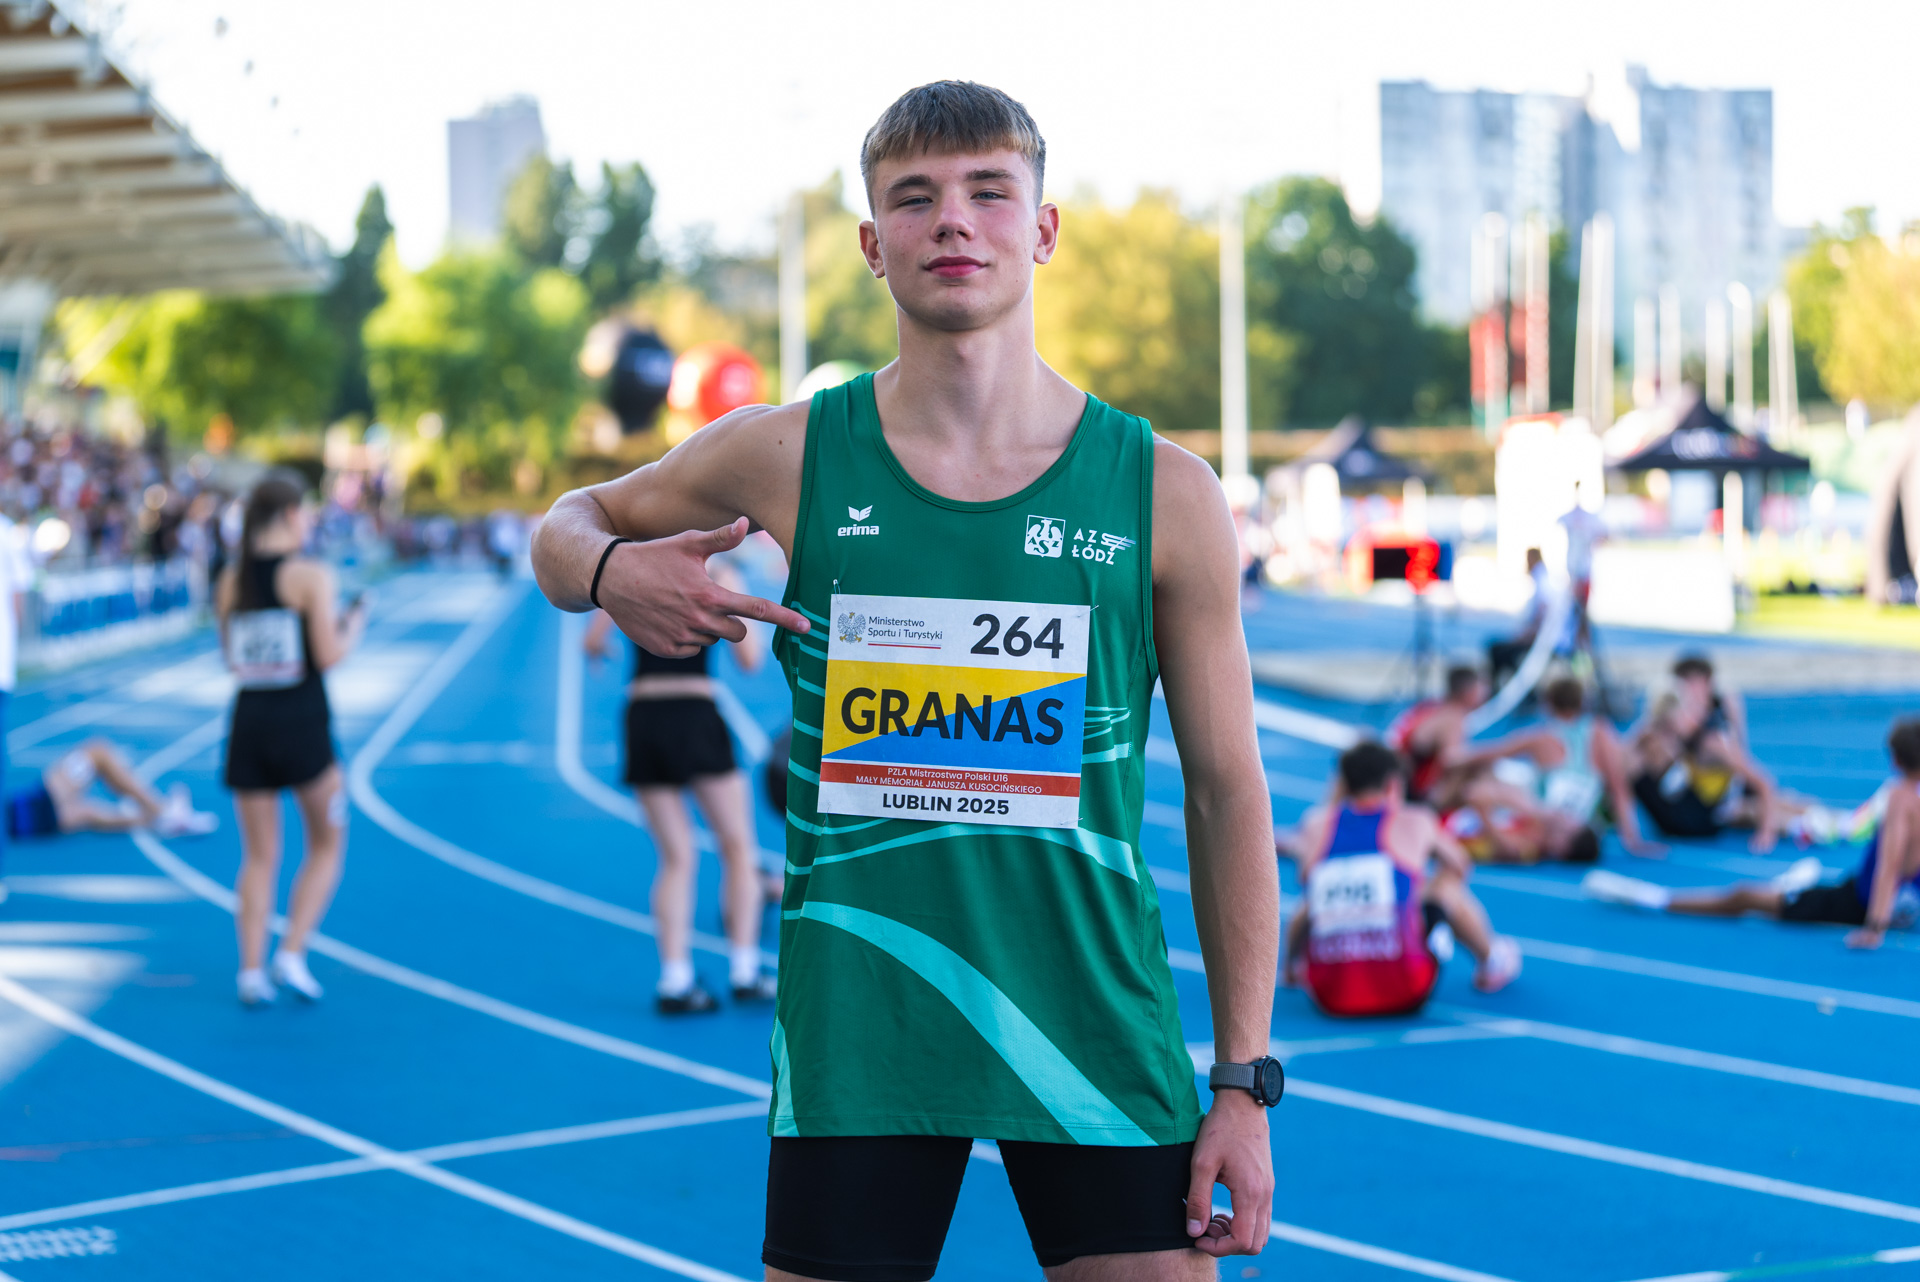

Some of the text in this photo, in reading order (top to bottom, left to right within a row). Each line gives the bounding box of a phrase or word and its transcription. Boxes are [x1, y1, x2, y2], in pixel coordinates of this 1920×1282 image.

[837, 524, 880, 537] erima
[868, 616, 925, 628] Ministerstwo
[867, 627, 896, 638] Sportu
[903, 629, 943, 641] Turystyki
[970, 613, 1065, 659] 264
[841, 687, 1065, 746] GRANAS
[887, 768, 1009, 783] PZLA Mistrzostwa Polski U16
[855, 775, 1042, 794] MAŁY MEMORIAŁ JANUSZA KUSOCIŃSKIEGO
[882, 793, 1010, 815] LUBLIN 2025
